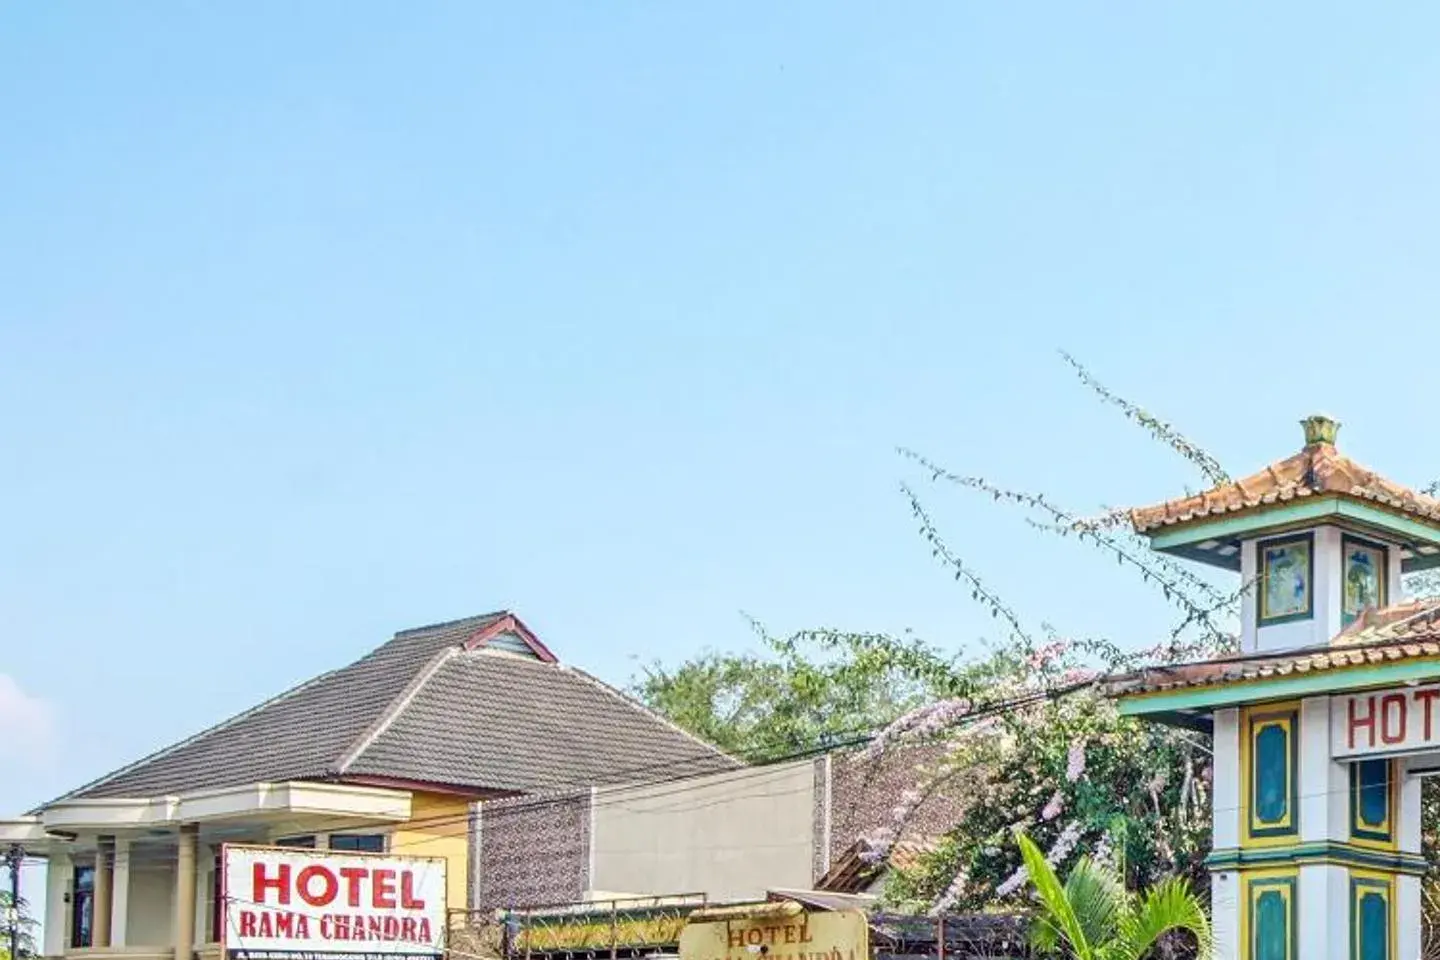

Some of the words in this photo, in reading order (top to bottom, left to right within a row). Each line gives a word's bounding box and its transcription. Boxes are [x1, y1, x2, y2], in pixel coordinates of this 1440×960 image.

[253, 863, 424, 909] HOTEL
[240, 911, 311, 939] RAMA
[320, 912, 432, 943] CHANDRA
[727, 925, 812, 947] HOTEL
